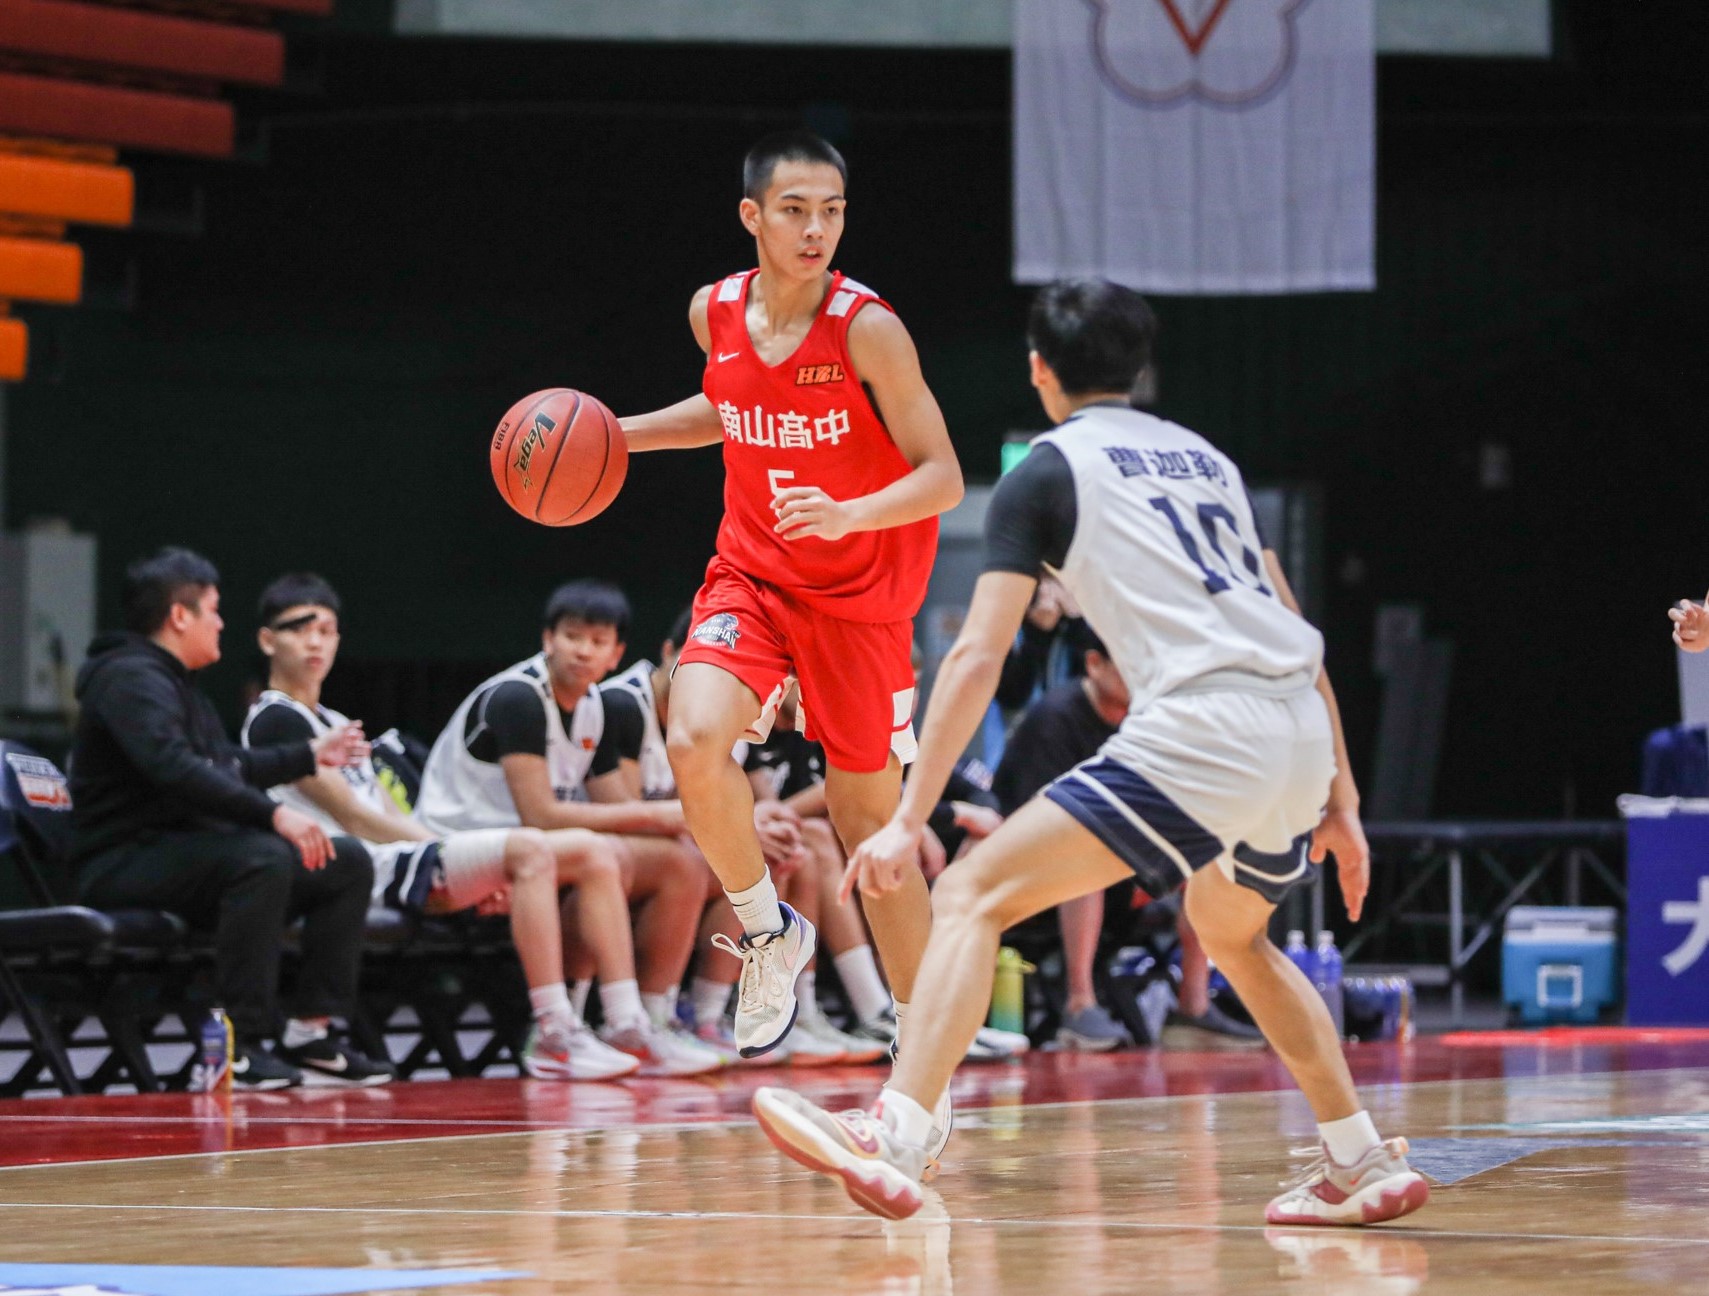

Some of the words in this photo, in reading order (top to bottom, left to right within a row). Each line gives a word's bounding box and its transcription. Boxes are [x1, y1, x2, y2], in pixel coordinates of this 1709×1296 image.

[796, 364, 844, 386] HBL
[493, 421, 510, 450] FIBA
[516, 410, 558, 472] Vega
[1148, 495, 1272, 598] 10
